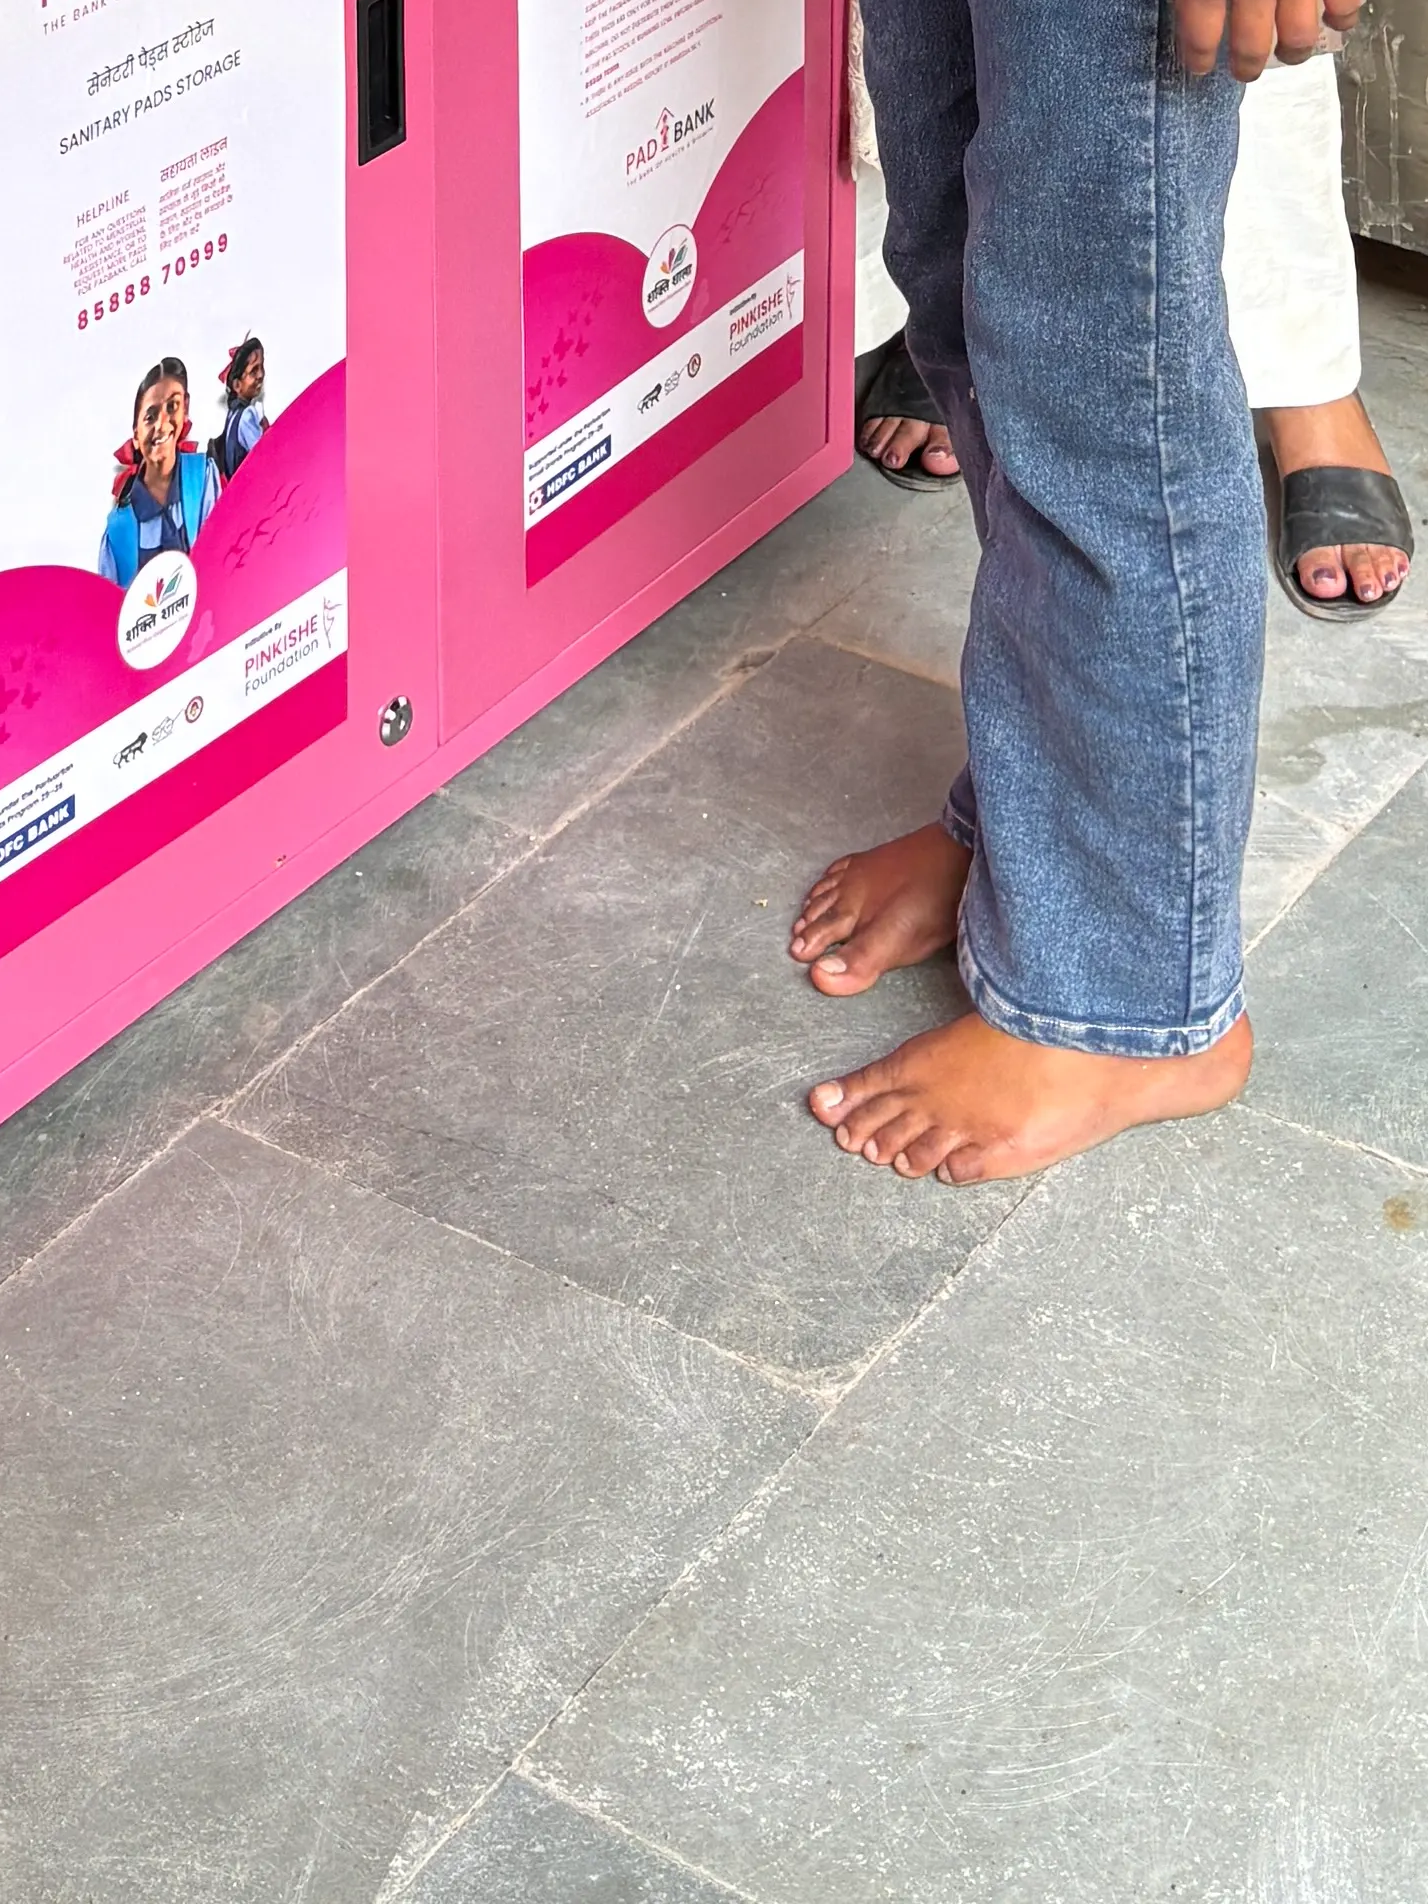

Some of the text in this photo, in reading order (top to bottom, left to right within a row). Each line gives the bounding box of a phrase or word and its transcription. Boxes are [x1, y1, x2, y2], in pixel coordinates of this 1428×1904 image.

[43, 13, 65, 36] THE
[87, 52, 134, 97] सेनेटरी
[172, 12, 214, 56] स्टोरेज
[59, 48, 240, 156] SANITARY PADS STORAGE
[626, 97, 714, 175] PAD BANK
[160, 151, 197, 184] सहायता
[76, 188, 129, 228] HELPLINE
[77, 231, 227, 331] 85888 70999
[729, 286, 782, 340] PINKISHE
[546, 442, 607, 498] HDFC BANK
[125, 606, 157, 645] शक्ति
[161, 592, 188, 622] शाला
[245, 613, 317, 679] PINKISHE
[245, 635, 318, 697] Foundation
[27, 802, 69, 843] BANK
